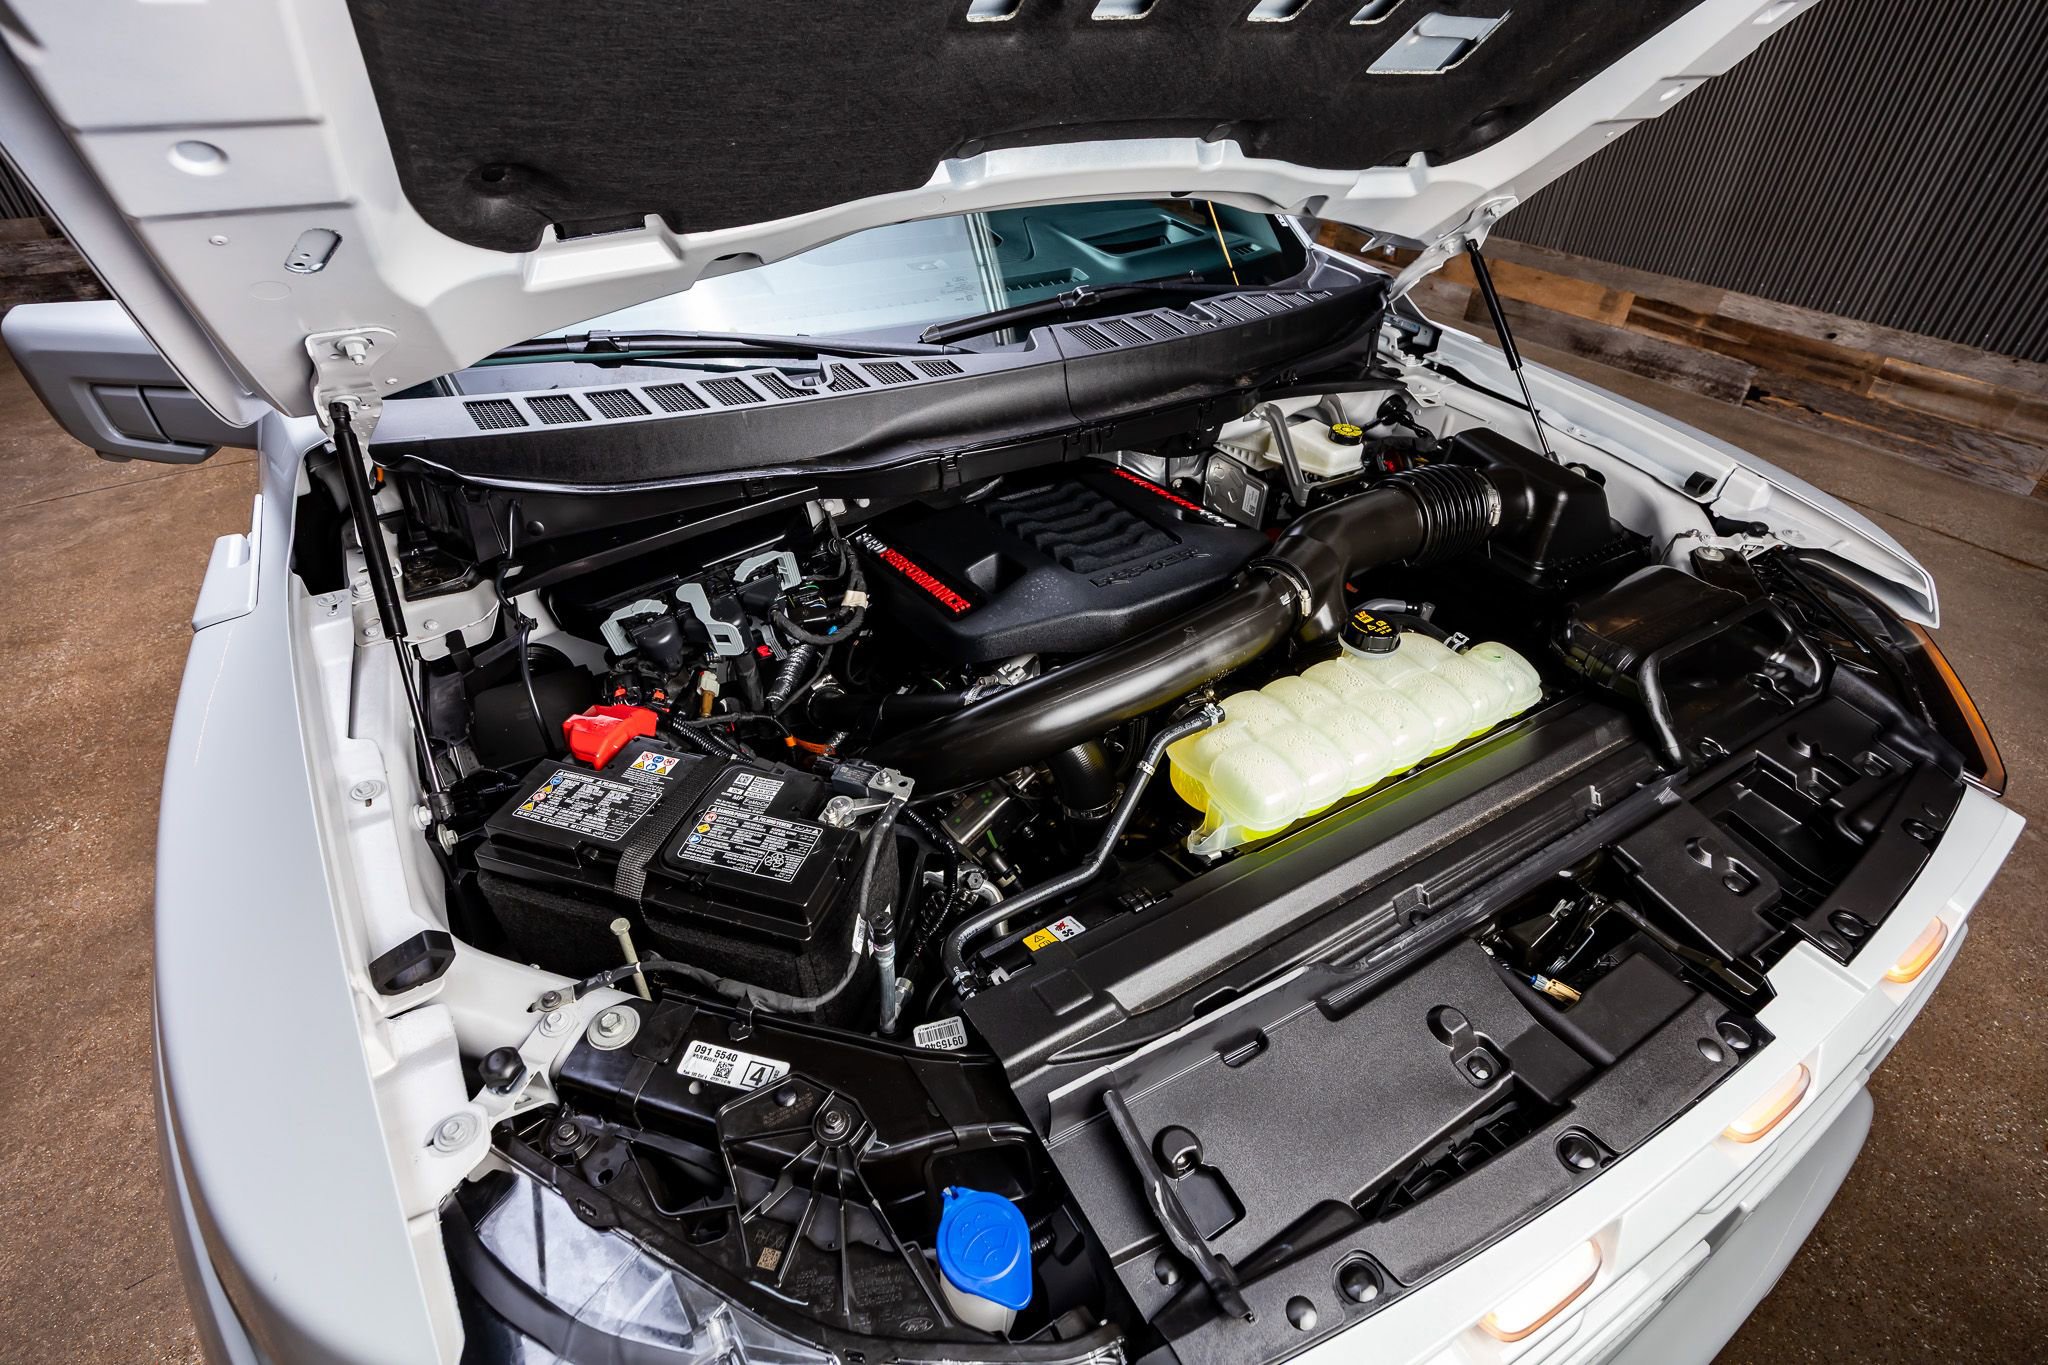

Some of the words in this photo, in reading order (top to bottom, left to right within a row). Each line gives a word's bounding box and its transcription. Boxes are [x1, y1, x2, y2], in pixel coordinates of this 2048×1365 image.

[879, 547, 972, 613] PERFORMANCE
[694, 1044, 712, 1056] 091
[714, 1049, 738, 1062] 5540
[748, 1066, 767, 1086] 4
